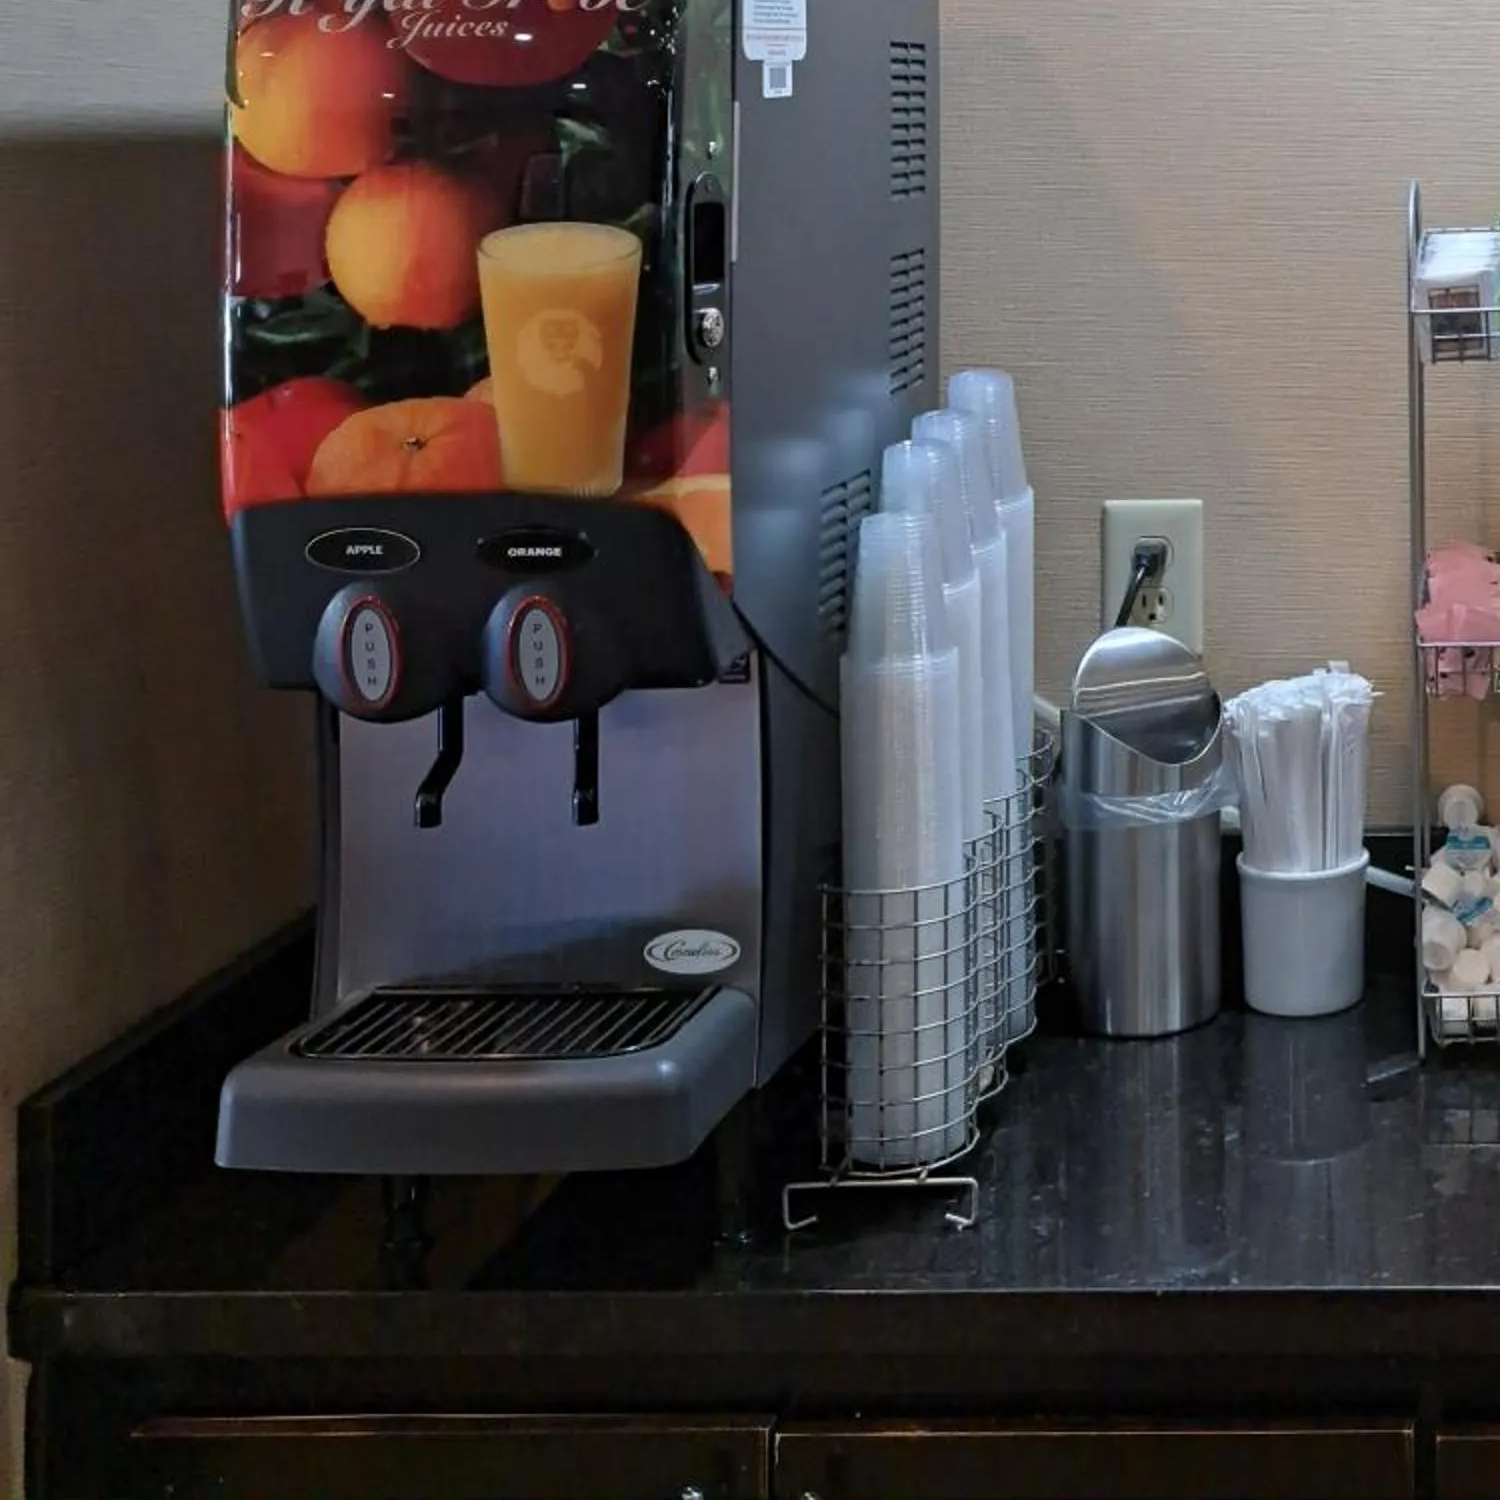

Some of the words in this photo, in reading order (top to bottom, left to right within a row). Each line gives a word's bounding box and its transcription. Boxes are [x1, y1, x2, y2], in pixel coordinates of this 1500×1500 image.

[387, 10, 509, 49] Juices
[345, 544, 384, 556] APPLE
[507, 546, 562, 558] ORANGE
[364, 622, 378, 686] PUSH
[532, 622, 546, 686] PUSH
